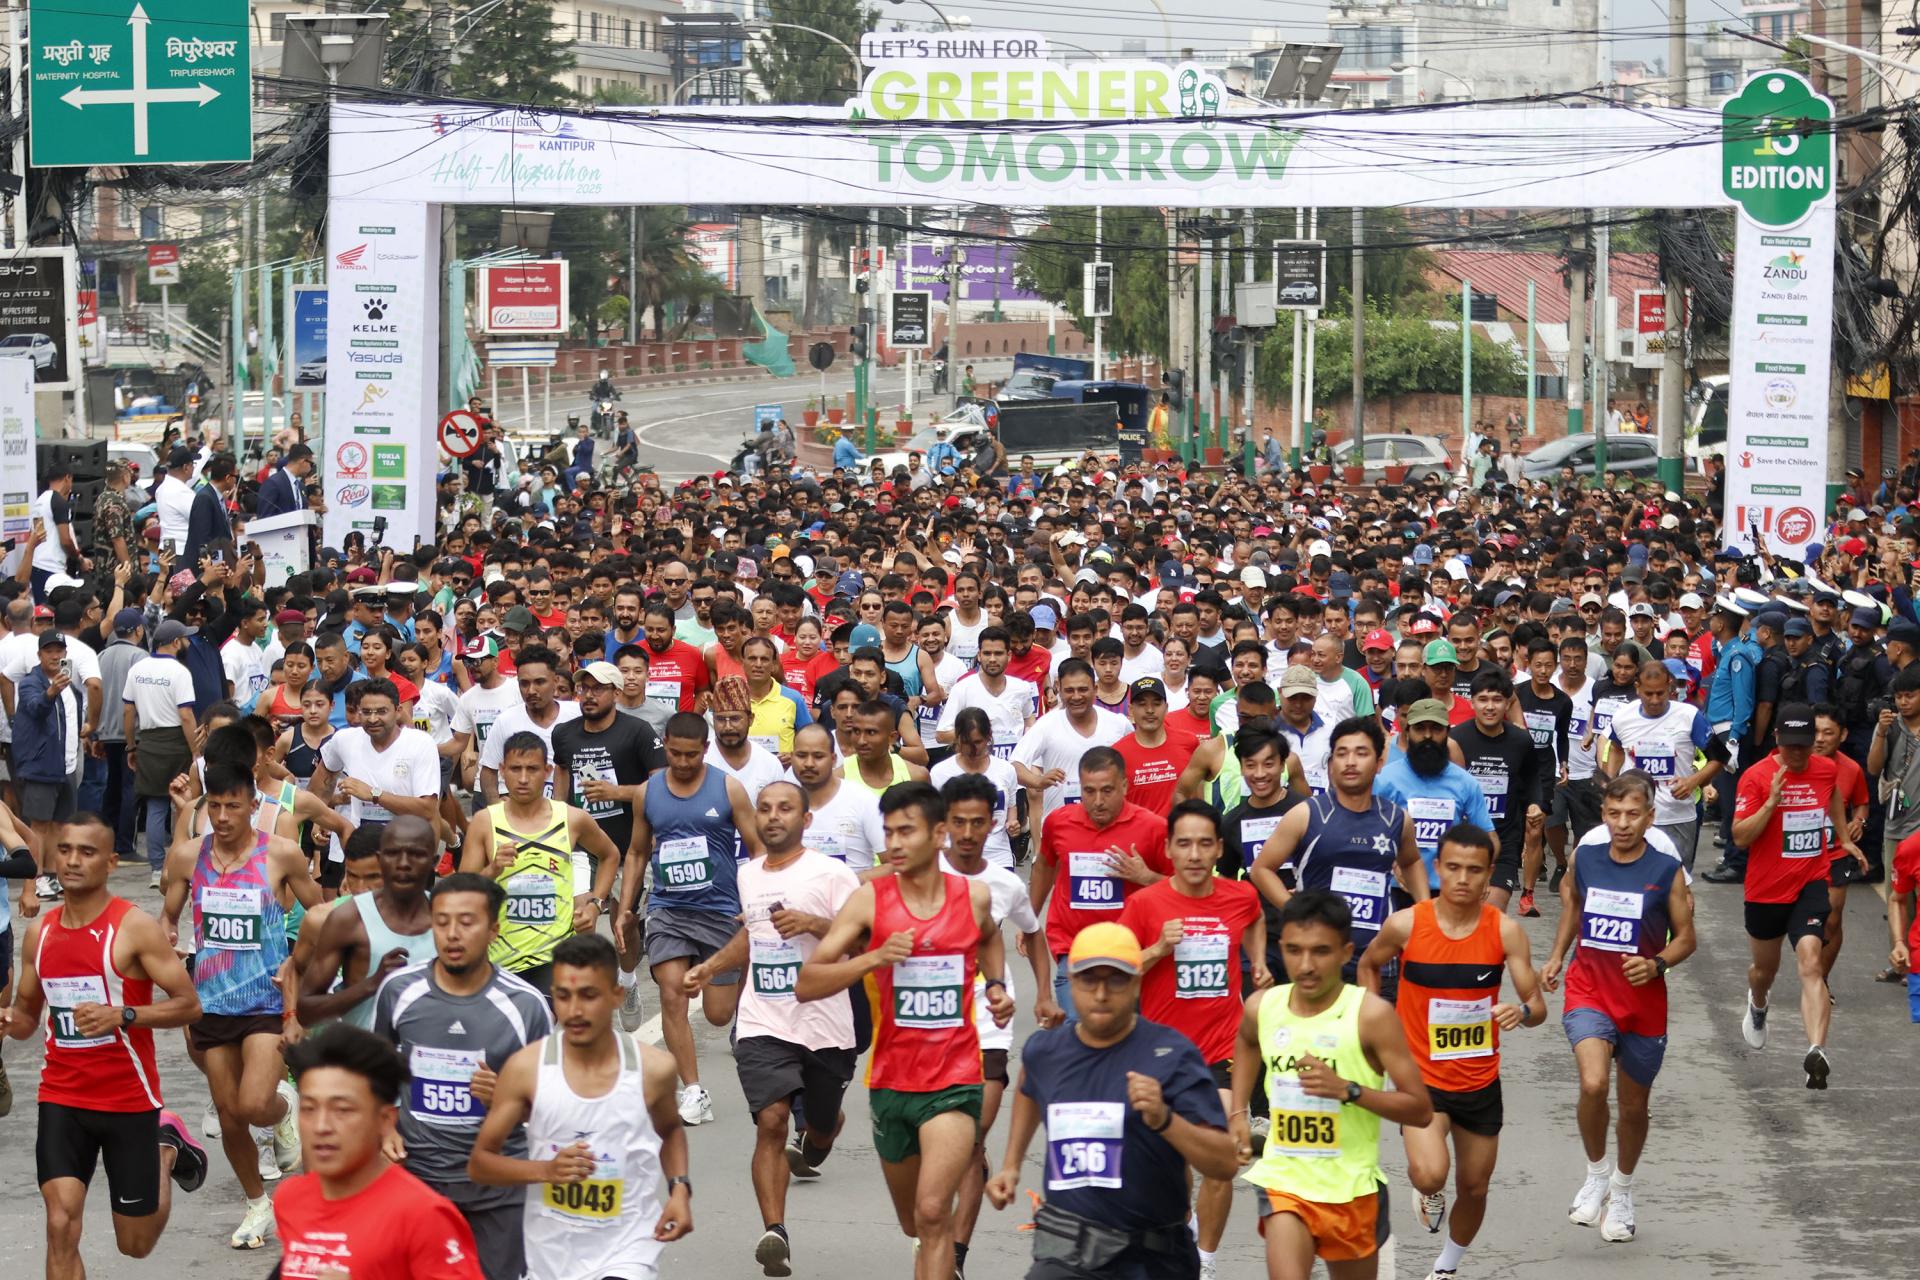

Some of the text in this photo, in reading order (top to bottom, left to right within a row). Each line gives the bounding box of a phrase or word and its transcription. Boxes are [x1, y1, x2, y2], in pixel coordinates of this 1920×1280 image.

[88, 44, 112, 65] गृह
[166, 37, 238, 63] त्रिपुरेश्वर
[869, 38, 1038, 58] LET'S RUN FOR
[36, 71, 120, 81] MATERNITY HOSPITAL
[169, 67, 235, 77] TRIPURESHWOR
[871, 71, 1172, 120] GREENER
[452, 115, 543, 128] Global IME Bank
[539, 141, 595, 151] KANTIPUR
[869, 132, 1299, 183] TOMORROW
[1731, 165, 1824, 189] EDITION
[576, 184, 602, 194] 2025
[1763, 266, 1807, 280] ZANDU
[13, 290, 41, 298] ATTO
[1761, 291, 1807, 301] ZANDU Balm
[353, 324, 397, 333] KELME
[347, 351, 403, 363] Yasuda
[1757, 457, 1818, 466] Save the Children
[341, 489, 366, 505] Real
[135, 675, 171, 687] Yasuda
[1643, 759, 1668, 774] 284
[1414, 821, 1447, 839] 1221
[1787, 832, 1820, 850] 1928
[665, 861, 707, 884] 1590
[1078, 879, 1114, 900] 450
[506, 897, 556, 919] 2053
[208, 916, 254, 940] 2061
[1588, 917, 1633, 943] 1228
[757, 965, 798, 990] 1564
[1177, 963, 1226, 988] 3132
[899, 989, 958, 1017] 2058
[1436, 1026, 1485, 1049] 5010
[1271, 1055, 1337, 1073] KAI
[423, 1083, 472, 1113] 555
[1278, 1114, 1335, 1144] 5053
[1061, 1142, 1107, 1175] 256
[552, 1182, 616, 1213] 5043
